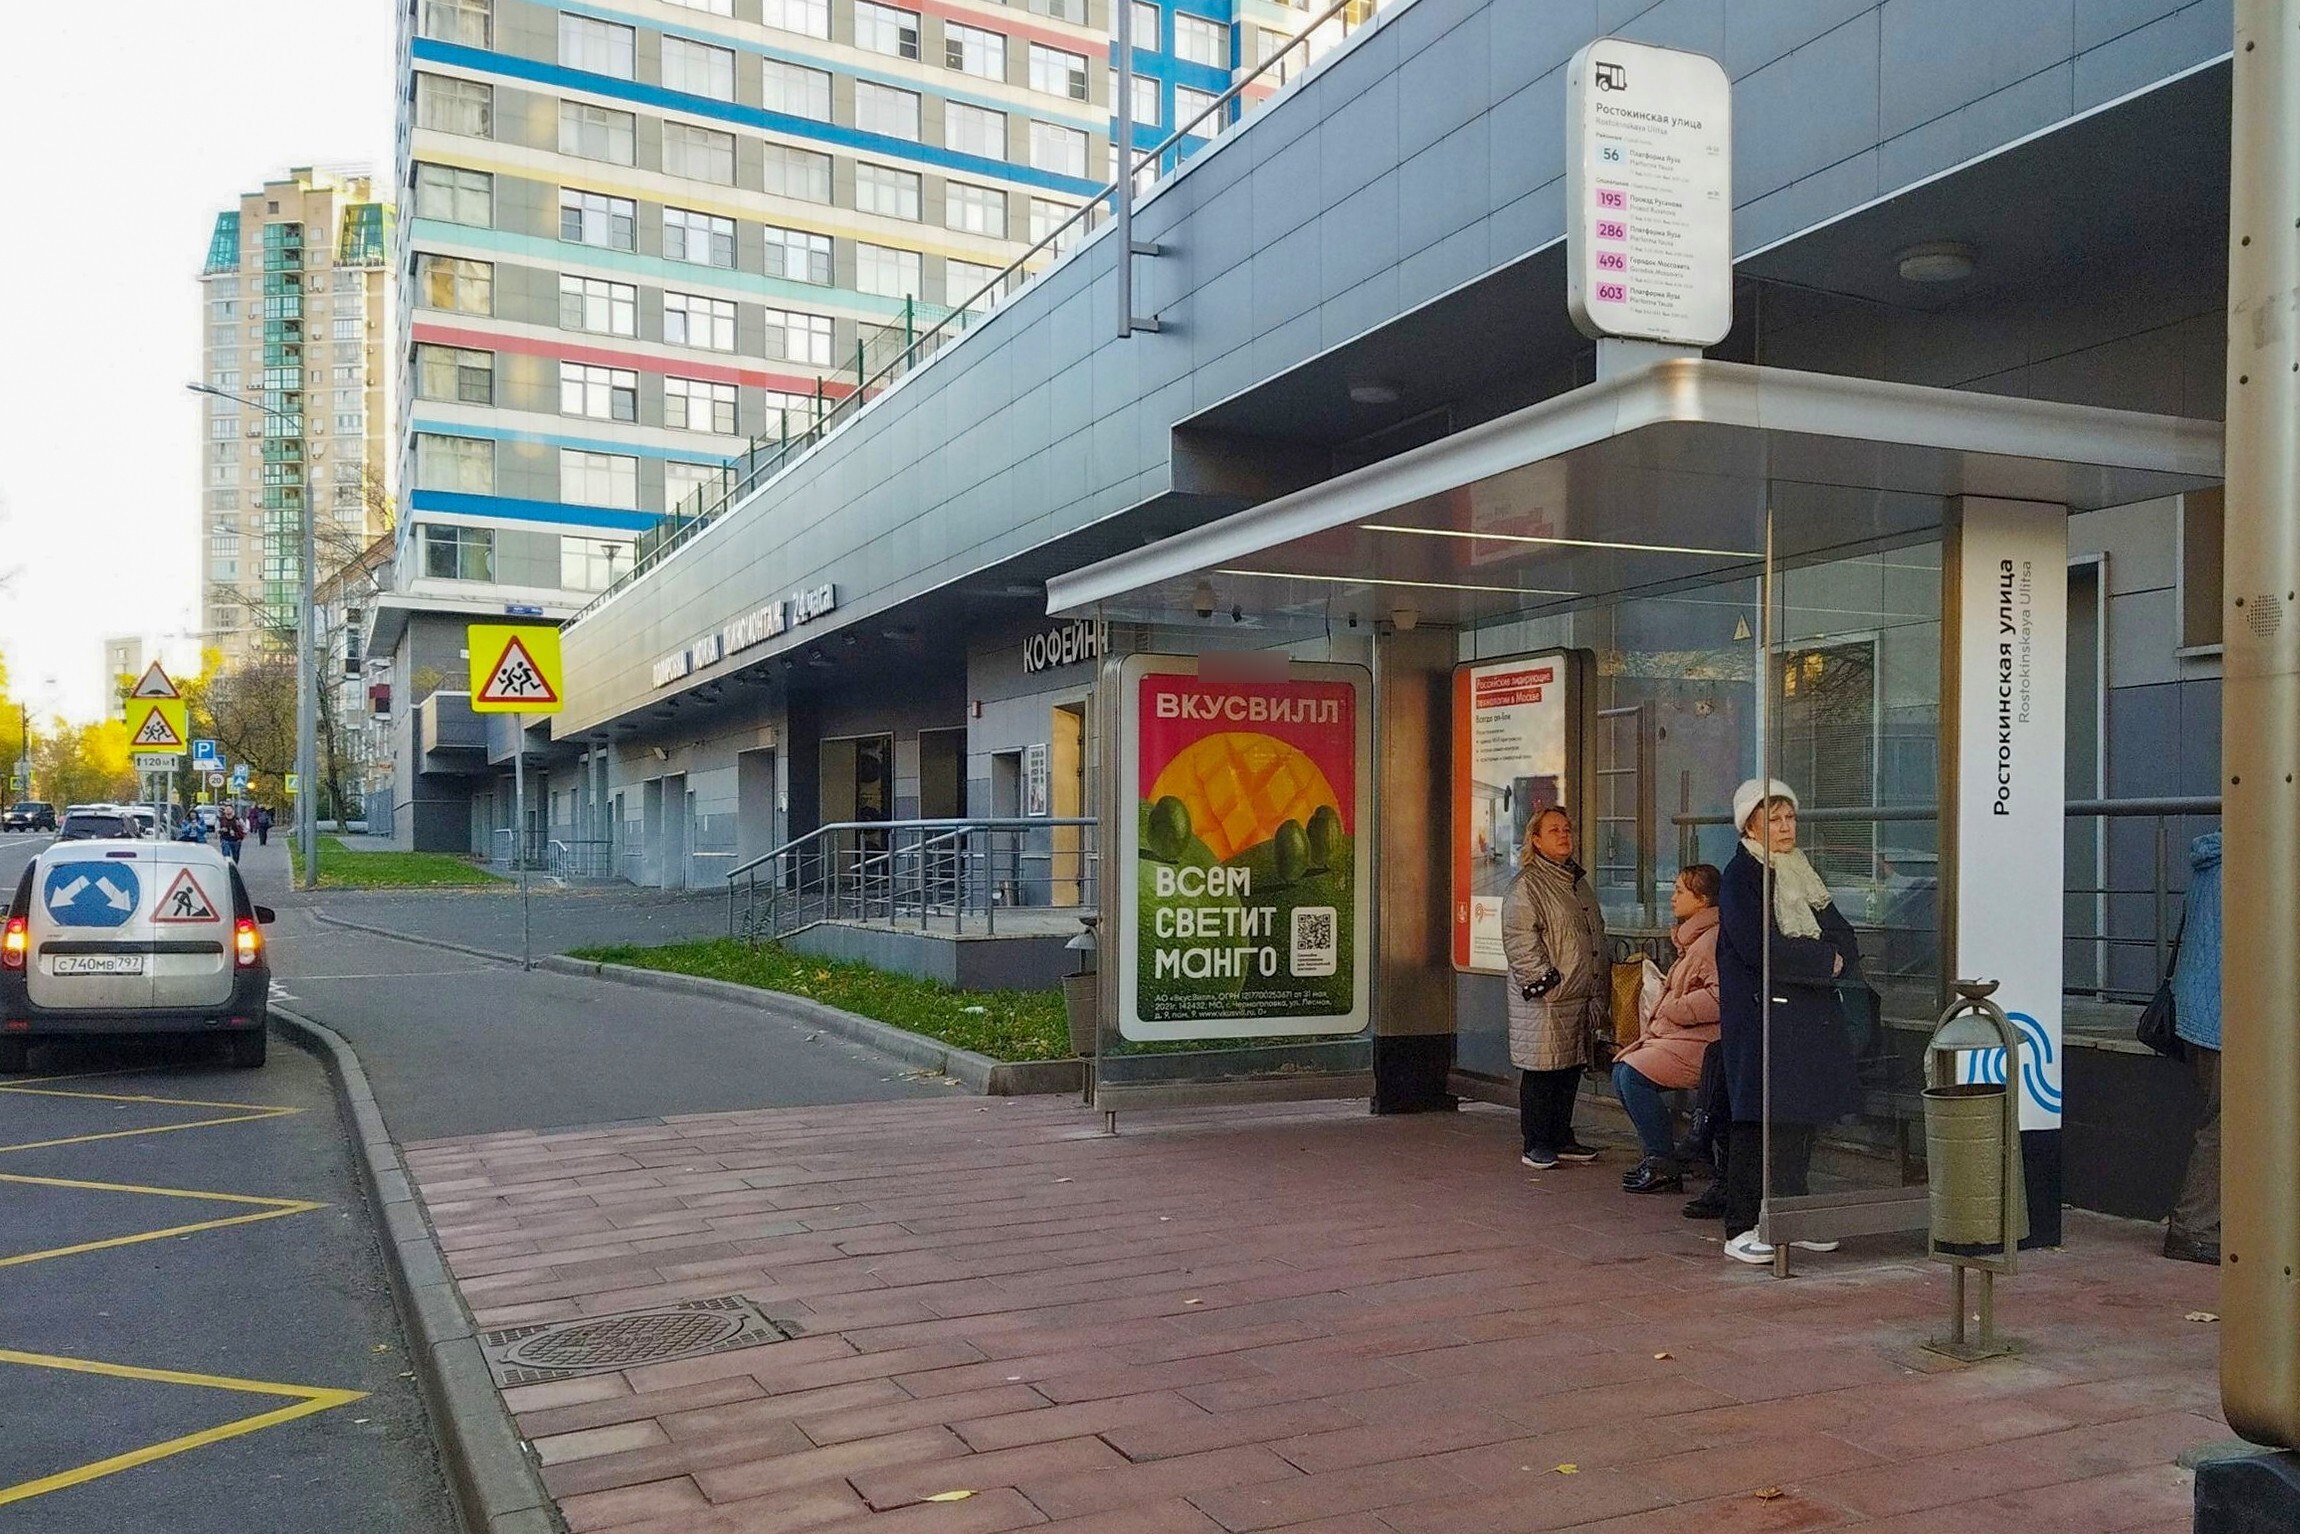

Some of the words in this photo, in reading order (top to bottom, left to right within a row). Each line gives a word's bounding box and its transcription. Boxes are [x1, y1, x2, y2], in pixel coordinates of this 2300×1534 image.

[1596, 103, 1669, 124] Ростокинская
[1672, 117, 1702, 130] улица
[1603, 148, 1619, 161] 56
[1601, 192, 1622, 207] 195
[1600, 223, 1624, 238] 286
[1600, 254, 1624, 269] 496
[1600, 286, 1623, 300] 603
[2020, 561, 2032, 604] Ulitsa
[2000, 559, 2016, 635] улица
[2019, 609, 2033, 723] Rostokinskaya
[1156, 693, 1339, 723] ВКУСВИЛЛ
[1994, 643, 2012, 816] Ростокинская
[198, 743, 210, 757] P
[144, 758, 160, 766] 120
[1156, 906, 1277, 938] СВЕТИТ
[118, 957, 139, 968] 797
[1155, 994, 1168, 1003] АО
[1218, 992, 1240, 1001] ОГРН
